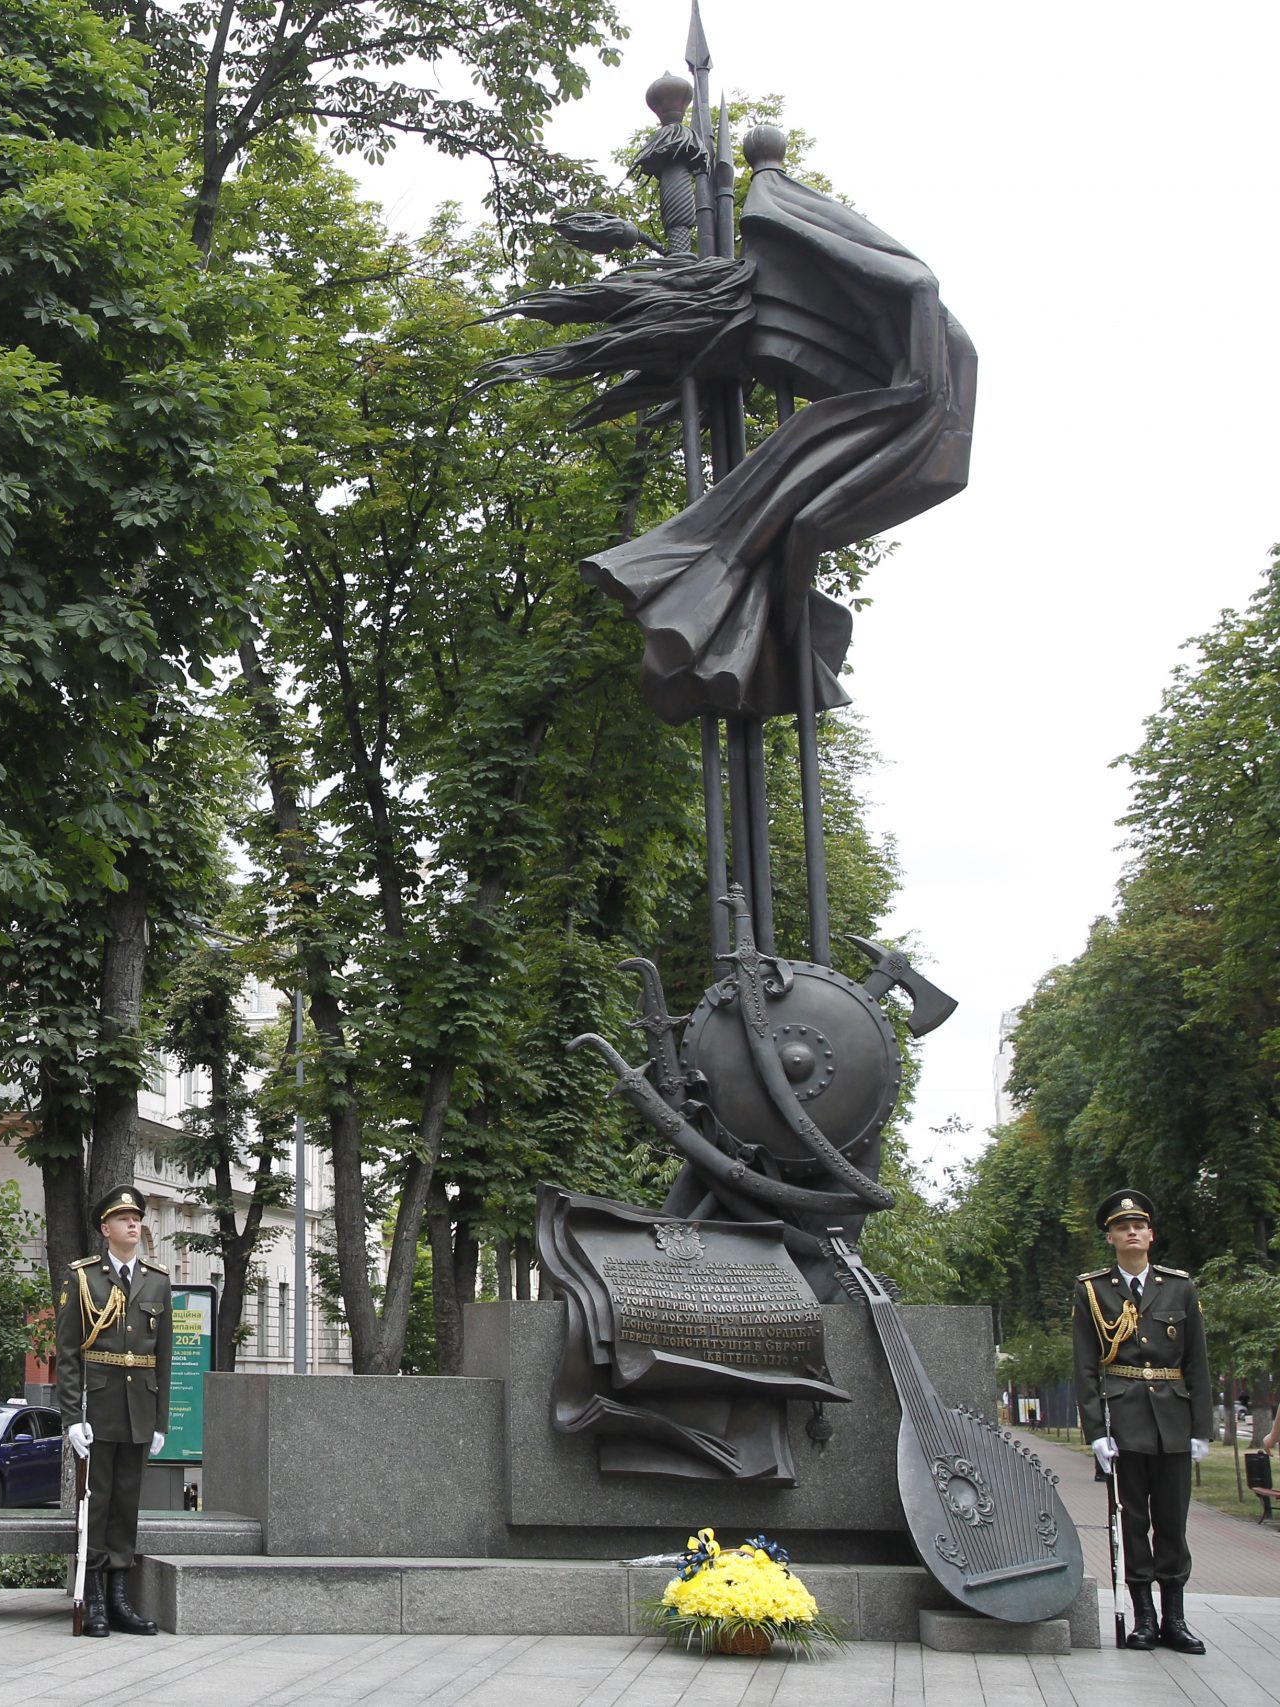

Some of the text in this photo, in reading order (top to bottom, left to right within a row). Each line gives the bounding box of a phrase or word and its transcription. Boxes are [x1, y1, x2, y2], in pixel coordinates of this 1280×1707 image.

[172, 1311, 202, 1320] аційна
[804, 1312, 821, 1321] ЯК
[175, 1335, 201, 1345] 2021
